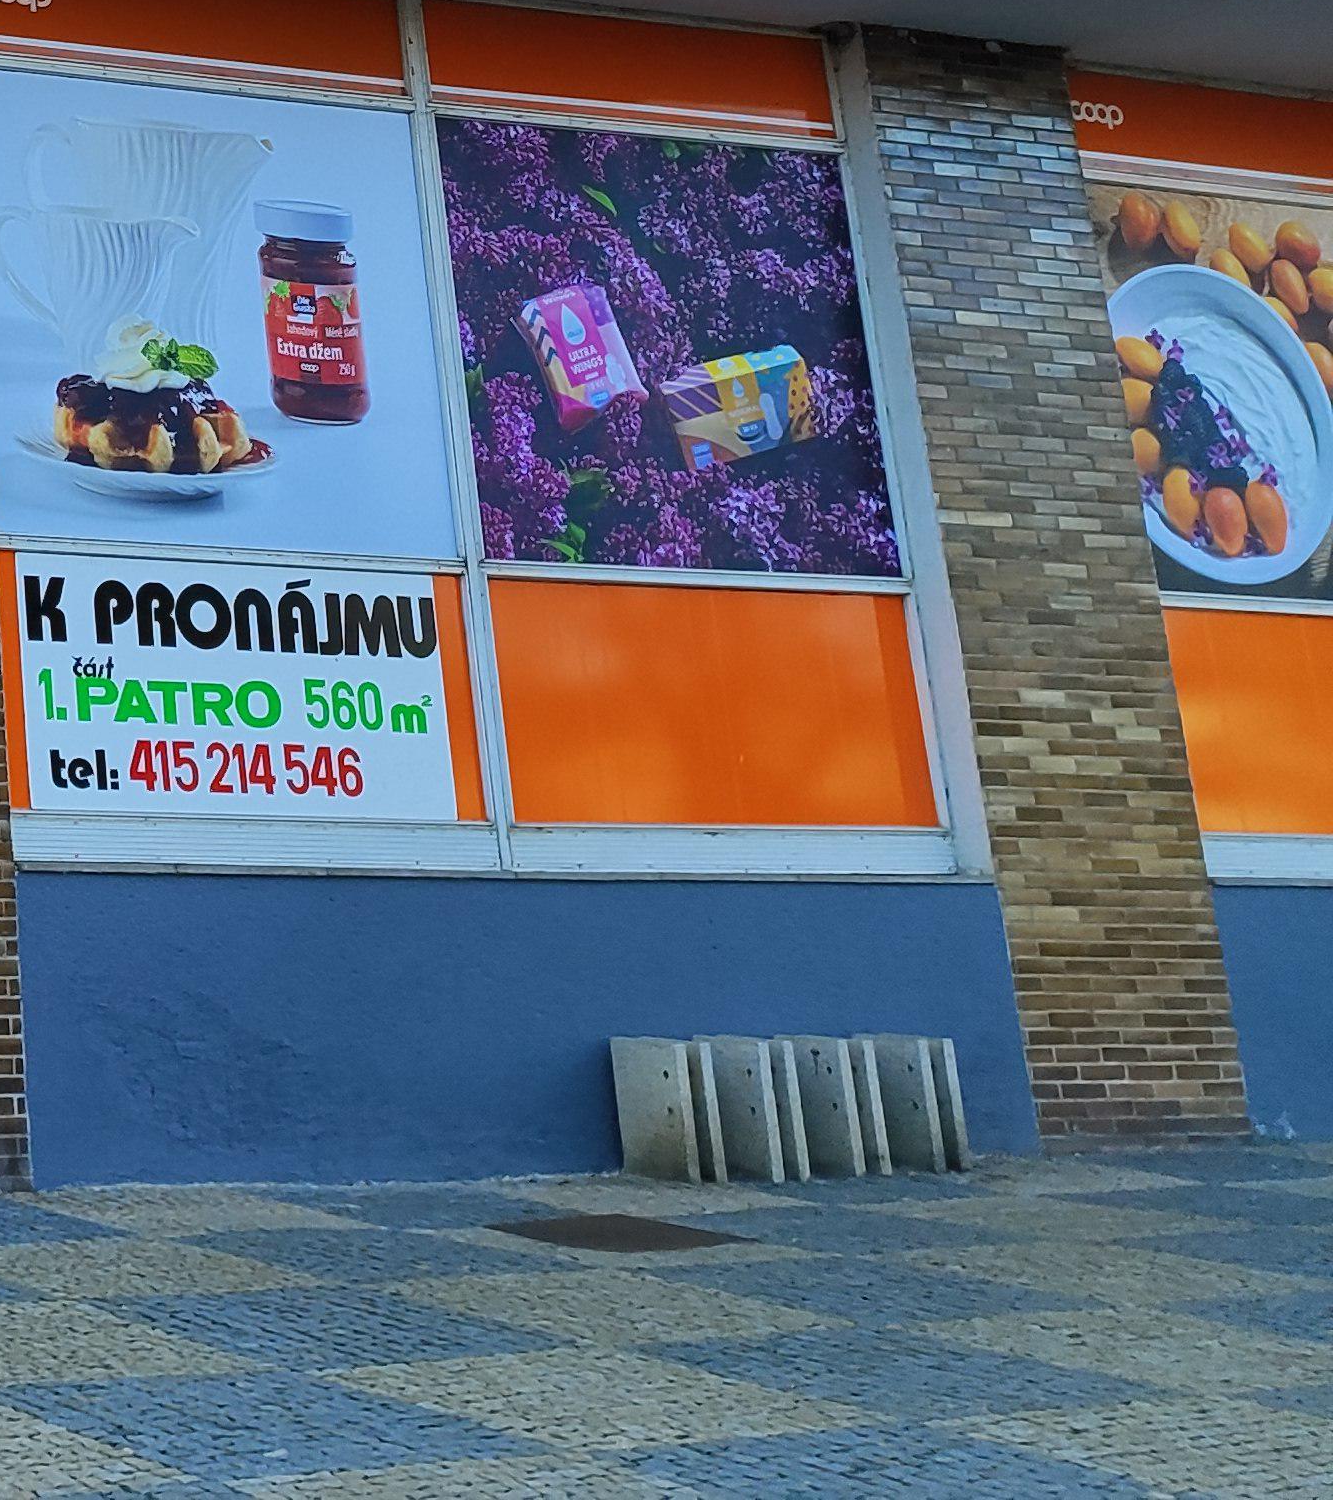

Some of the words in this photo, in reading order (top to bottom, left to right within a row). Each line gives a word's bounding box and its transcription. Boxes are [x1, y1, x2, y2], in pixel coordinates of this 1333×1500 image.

[1069, 99, 1125, 131] coop
[276, 337, 308, 359] Extra
[309, 341, 343, 361] džem
[23, 574, 68, 642] K
[93, 578, 438, 659] PRONÁJMU
[75, 677, 282, 729] PATRO
[303, 678, 384, 732] 560
[49, 748, 119, 791] tel:
[129, 739, 199, 793] 415
[207, 741, 276, 796] 214
[283, 743, 364, 798] 546
